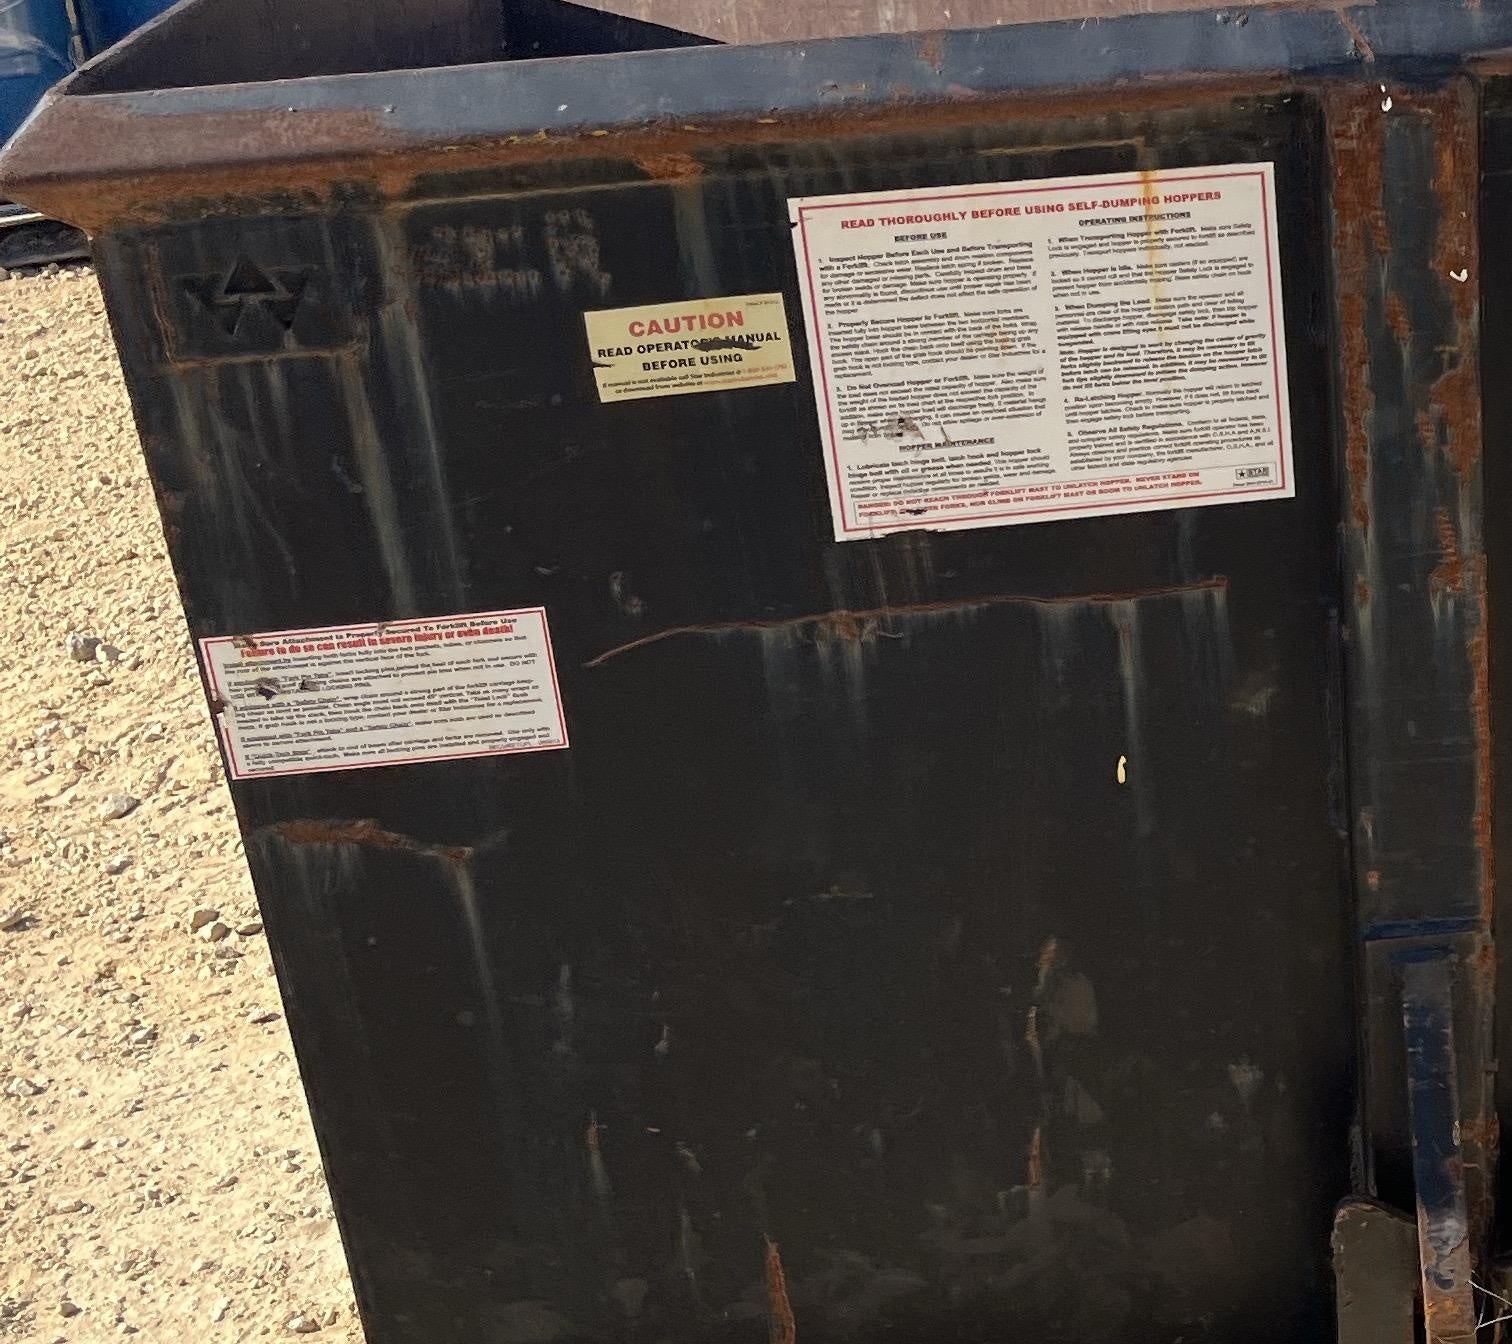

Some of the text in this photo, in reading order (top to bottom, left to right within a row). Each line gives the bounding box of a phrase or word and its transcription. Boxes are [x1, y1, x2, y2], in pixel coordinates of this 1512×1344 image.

[840, 191, 1221, 228] READ THOROUGHLY BEFORE USING SELF-DUMPING HOPPERS
[1079, 211, 1190, 226] OPERATING INSTRUCTIONS
[894, 233, 927, 242] BEFORE
[627, 310, 744, 338] CAUTION
[597, 346, 633, 358] READ
[642, 353, 742, 371] BEFORE USING
[899, 437, 994, 451] HOPPER MAINTENANCE
[240, 624, 513, 657] Failure to do so can result in severe injury or even death!
